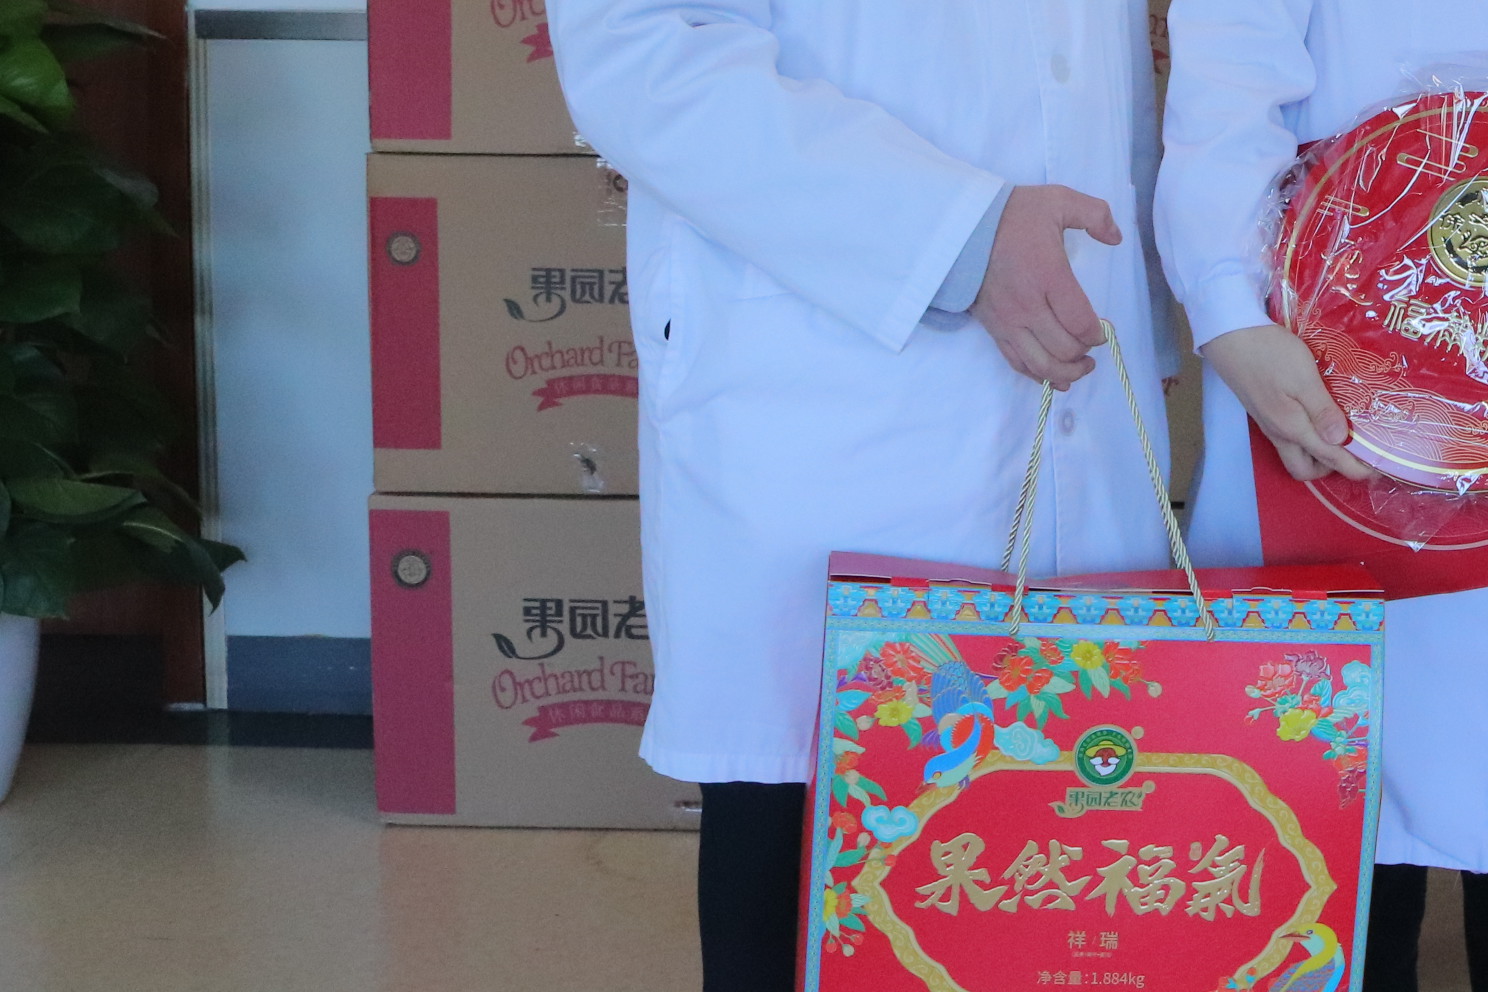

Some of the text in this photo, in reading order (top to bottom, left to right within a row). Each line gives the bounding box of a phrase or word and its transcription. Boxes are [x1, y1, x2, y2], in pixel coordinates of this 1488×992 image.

[530, 266, 628, 314] 果园老
[505, 336, 604, 381] Orchard
[522, 595, 650, 650] 果园老
[491, 656, 605, 710] Orchard
[1068, 789, 1143, 812] 果园老农
[914, 832, 1265, 922] 果然福氣
